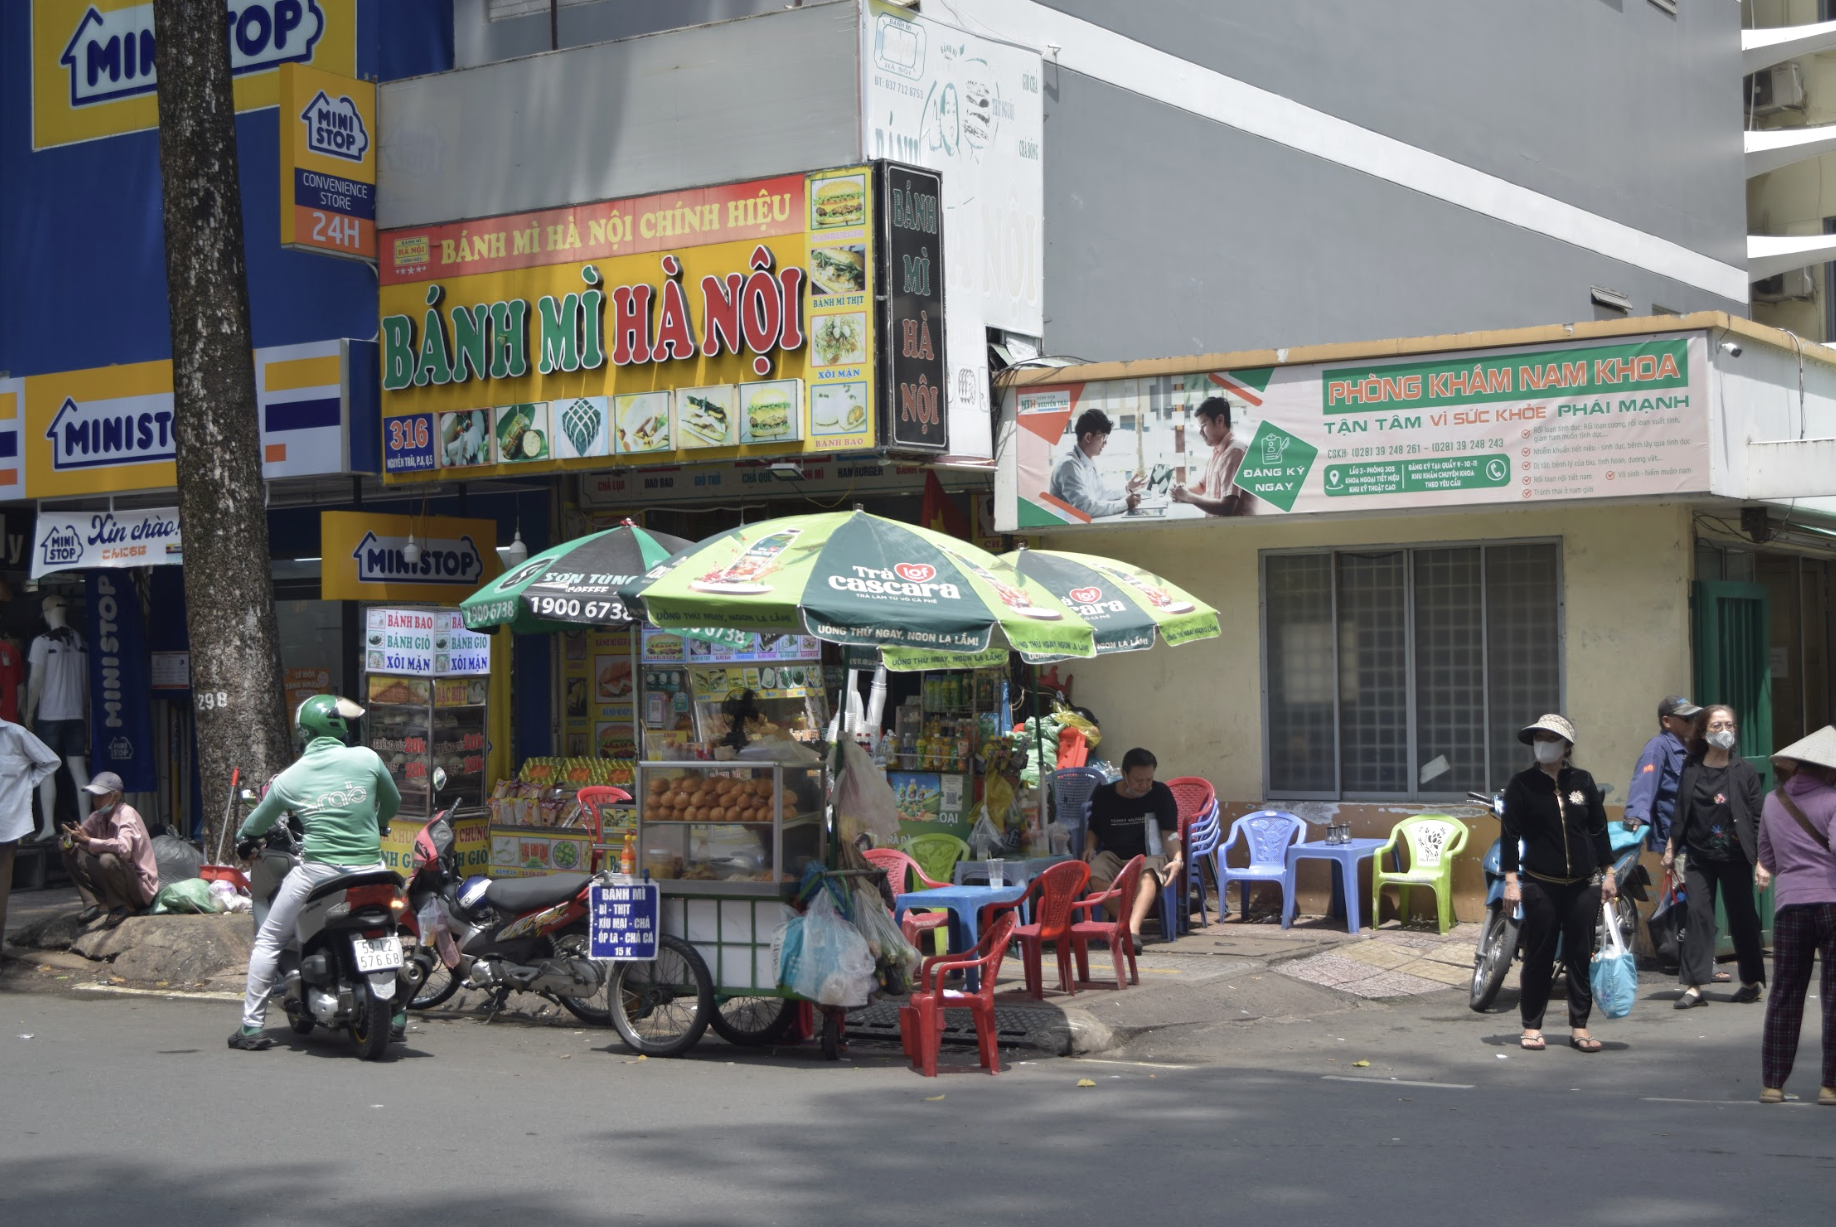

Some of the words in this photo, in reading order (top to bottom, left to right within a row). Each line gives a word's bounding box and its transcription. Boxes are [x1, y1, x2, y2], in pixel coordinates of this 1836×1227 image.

[897, 82, 908, 95] 712
[317, 107, 353, 132] MINI
[316, 126, 356, 151] STOP
[303, 172, 368, 199] CONVENIENCE
[320, 191, 352, 211] STORE
[892, 179, 938, 235] BÁNH
[312, 211, 360, 249] 24H
[440, 229, 507, 265] BÁNH
[512, 220, 540, 256] MÌ
[546, 216, 582, 251] HÀ
[588, 209, 634, 251] NỘI
[639, 201, 720, 238] CHÍNH
[726, 188, 792, 233] HIỆU
[811, 229, 866, 243] HAMBURGER
[398, 246, 409, 256] HÀ
[902, 246, 931, 297] MÌ
[812, 297, 835, 309] BÁNH
[835, 295, 846, 308] MÌ
[846, 294, 865, 307] THỊT
[381, 284, 527, 391] BÁNH
[537, 264, 603, 375] MÌ
[612, 254, 695, 367] HÀ
[700, 244, 803, 376] NỘI
[901, 310, 935, 361] HÀ
[817, 369, 837, 380] XÔI
[1328, 373, 1422, 406] PHÒNG
[1428, 363, 1512, 399] KHÁM
[1519, 360, 1587, 392] NAM
[1594, 353, 1680, 385] KHOA
[900, 373, 940, 436] NỘI
[1323, 418, 1368, 437] TẬN
[1375, 414, 1422, 431] TÂM
[1429, 411, 1448, 427] VÌ
[1452, 408, 1490, 425] SỨC
[1495, 402, 1547, 422] KHỎE
[1557, 399, 1611, 418] PHÁI
[1618, 394, 1690, 415] MẠNH
[65, 411, 177, 456] MINIST
[389, 417, 429, 451] 316
[814, 437, 840, 449] BÁNH
[841, 436, 865, 448] BAO
[1327, 448, 1349, 459] CSKH:
[1351, 446, 1373, 458] (028)
[1375, 445, 1386, 457] 39
[1388, 444, 1404, 456] 248
[1406, 443, 1421, 454] 261
[1431, 441, 1454, 453] (028)
[1456, 440, 1467, 451] 39
[1469, 439, 1485, 450] 248
[1488, 438, 1504, 449] 243
[742, 470, 757, 483] CHẢ
[814, 466, 824, 479] MÌ
[837, 466, 883, 479] HAMBURGER
[1242, 464, 1282, 478] ĐĂNG
[1285, 464, 1306, 477] KÝ
[1255, 482, 1294, 492] NGAY
[87, 514, 128, 546] Xin
[130, 514, 181, 539] chào!
[51, 535, 75, 548] MINI
[49, 547, 77, 561] STOP
[101, 544, 148, 560] こんにちは
[543, 572, 581, 584] SƠN
[852, 565, 896, 580] Trà
[903, 567, 929, 578] lof
[1076, 589, 1096, 601] lof
[466, 603, 490, 624] 1900
[490, 599, 514, 620] 6738
[531, 596, 581, 617] 1900
[387, 611, 413, 629] BÁNH
[414, 614, 433, 630] BAO
[387, 632, 412, 649] BÁNH
[414, 634, 431, 650] GIÒ
[451, 634, 473, 649] BÁNH
[474, 634, 487, 649] GIÒ
[817, 622, 847, 636] UỐNG
[850, 626, 872, 637] THỬ
[875, 628, 905, 641] NGAY,
[907, 631, 937, 643] NGON
[938, 634, 952, 646] LẠ
[954, 631, 980, 646] LẮM!
[98, 575, 123, 728] MINISTOP
[892, 656, 912, 666] UỐNG
[952, 654, 972, 663] NGON
[386, 653, 405, 670] XÔI
[406, 653, 431, 674] MẶN
[451, 653, 467, 670] XÔI
[468, 652, 488, 673] MẶN
[436, 682, 451, 705] ĐẶC
[451, 681, 467, 703] BIỆT
[404, 736, 427, 754] 20k
[463, 733, 484, 751] 20k
[404, 761, 427, 779] 25k
[463, 755, 484, 774] 25k
[300, 782, 367, 815] Grab
[887, 833, 899, 845] RÀ
[468, 844, 489, 866] GIÒ
[632, 886, 646, 900] MÌ
[598, 902, 607, 915] BÌ
[613, 903, 631, 917] THỊT
[598, 916, 611, 929] XÍU
[612, 917, 628, 931] MẠI
[634, 915, 651, 929] CHẢ
[598, 929, 609, 944] ỐP
[624, 930, 641, 944] CHẢ
[642, 931, 654, 944] CÁ
[360, 953, 400, 968] 576.68
[615, 947, 624, 956] 15
